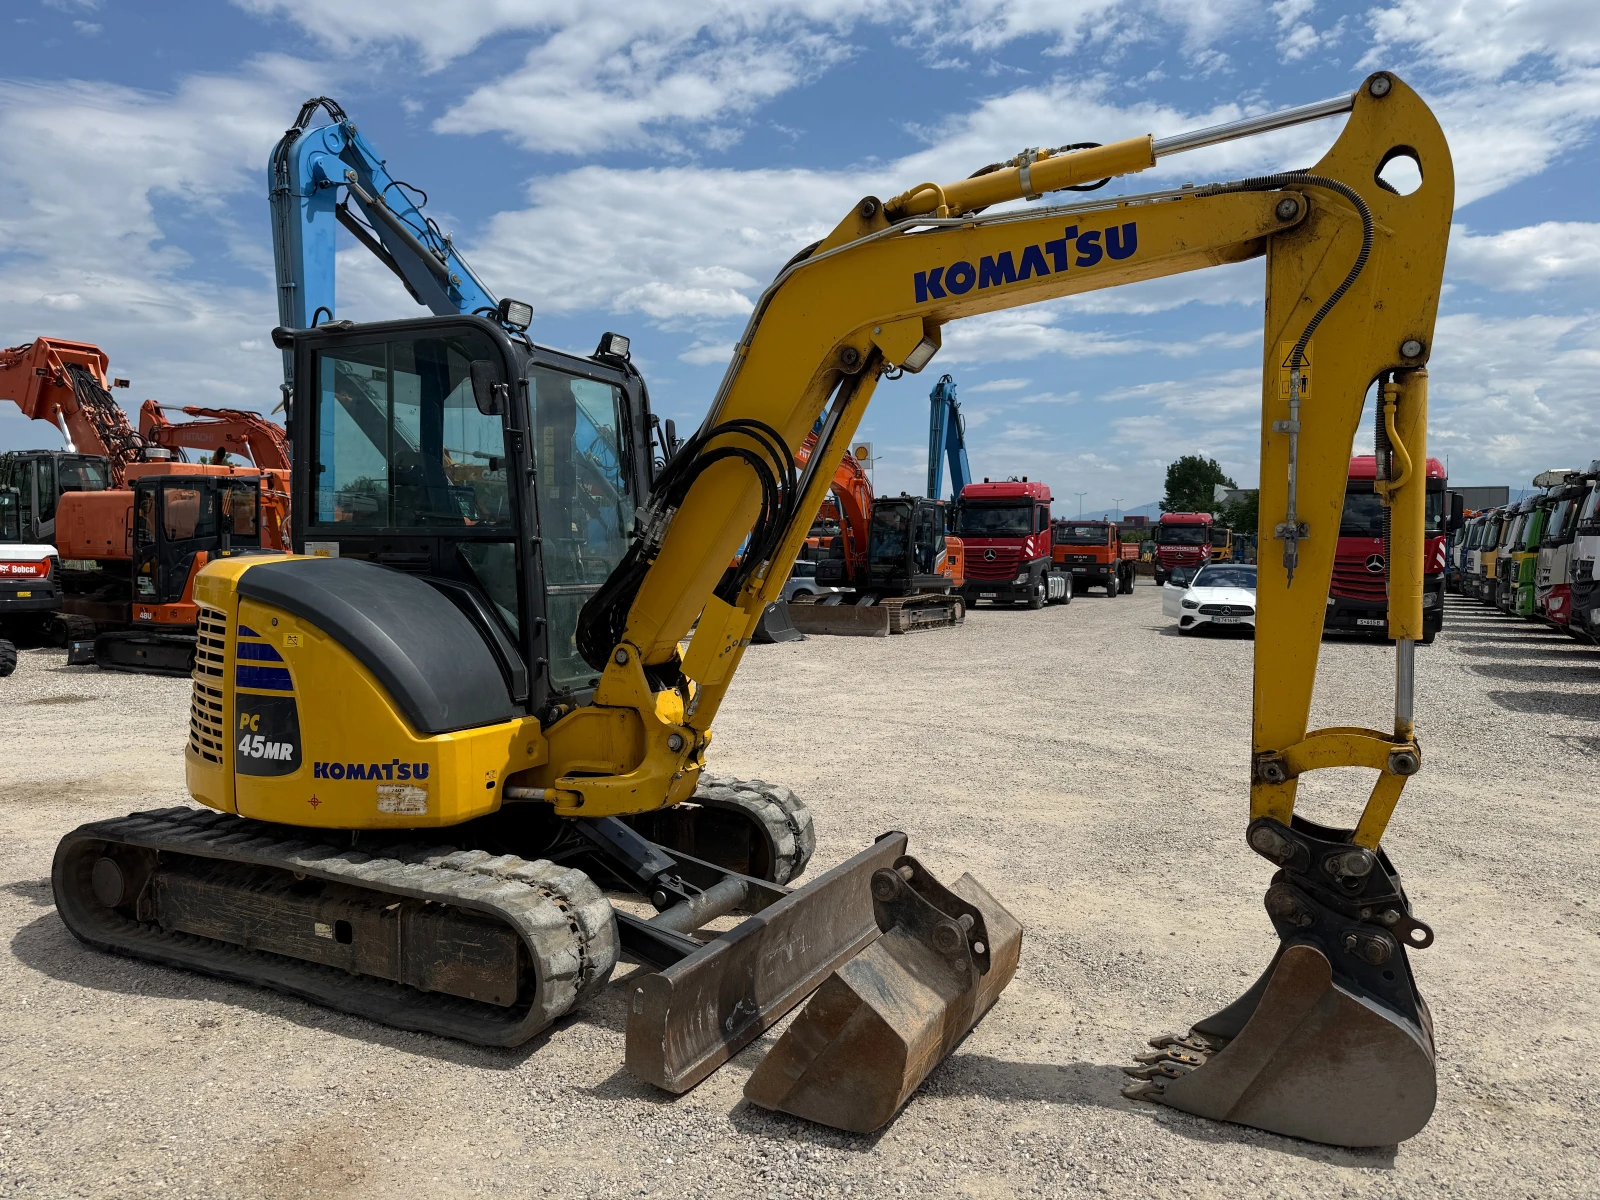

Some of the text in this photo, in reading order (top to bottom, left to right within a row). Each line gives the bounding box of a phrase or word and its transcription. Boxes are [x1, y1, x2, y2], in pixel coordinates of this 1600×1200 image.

[914, 222, 1138, 303] KOMATSU
[182, 432, 214, 441] HITACHI
[11, 565, 36, 573] Bobcat
[239, 713, 260, 732] PC
[238, 734, 294, 761] 45MR
[314, 759, 429, 780] KOMATSU
